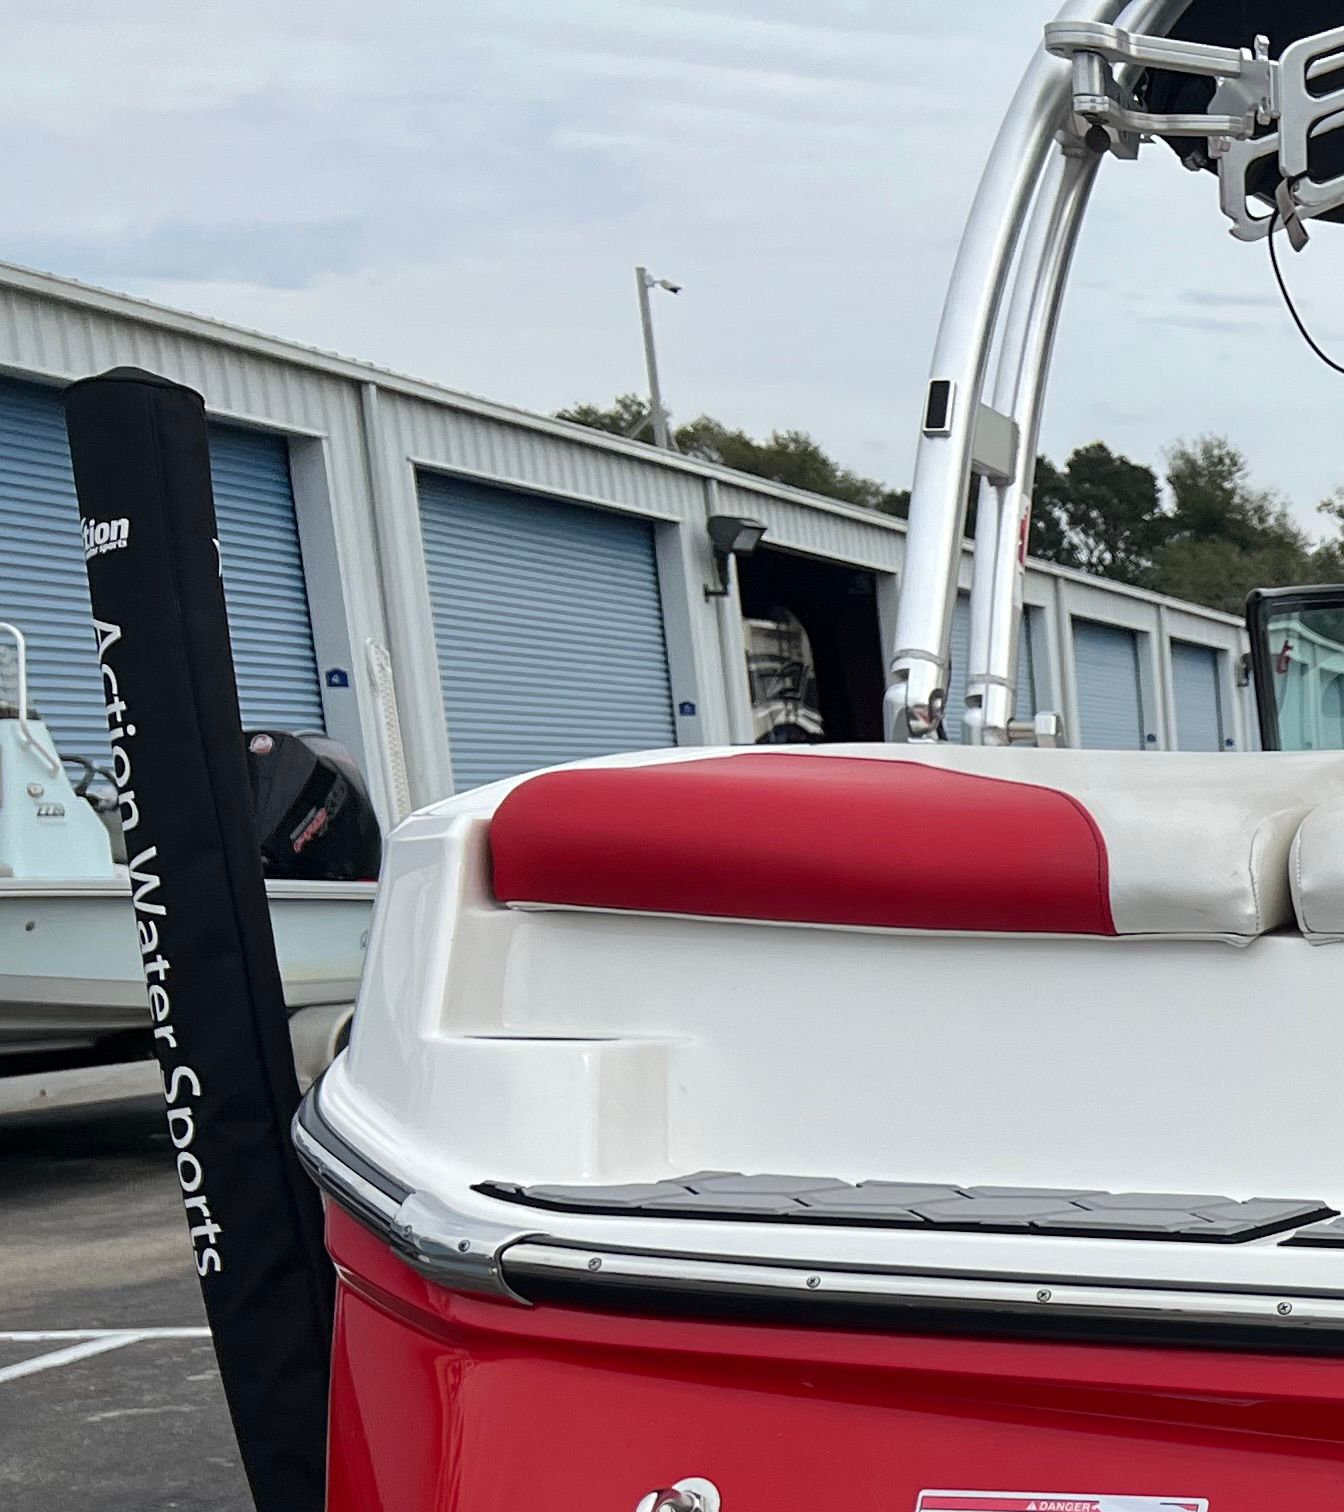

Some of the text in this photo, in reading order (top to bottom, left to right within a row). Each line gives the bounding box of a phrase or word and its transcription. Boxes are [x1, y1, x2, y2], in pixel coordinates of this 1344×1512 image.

[80, 517, 129, 550] tion
[129, 846, 177, 1048] Water
[162, 1066, 222, 1277] Sports
[1039, 1501, 1091, 1512] DANGER
